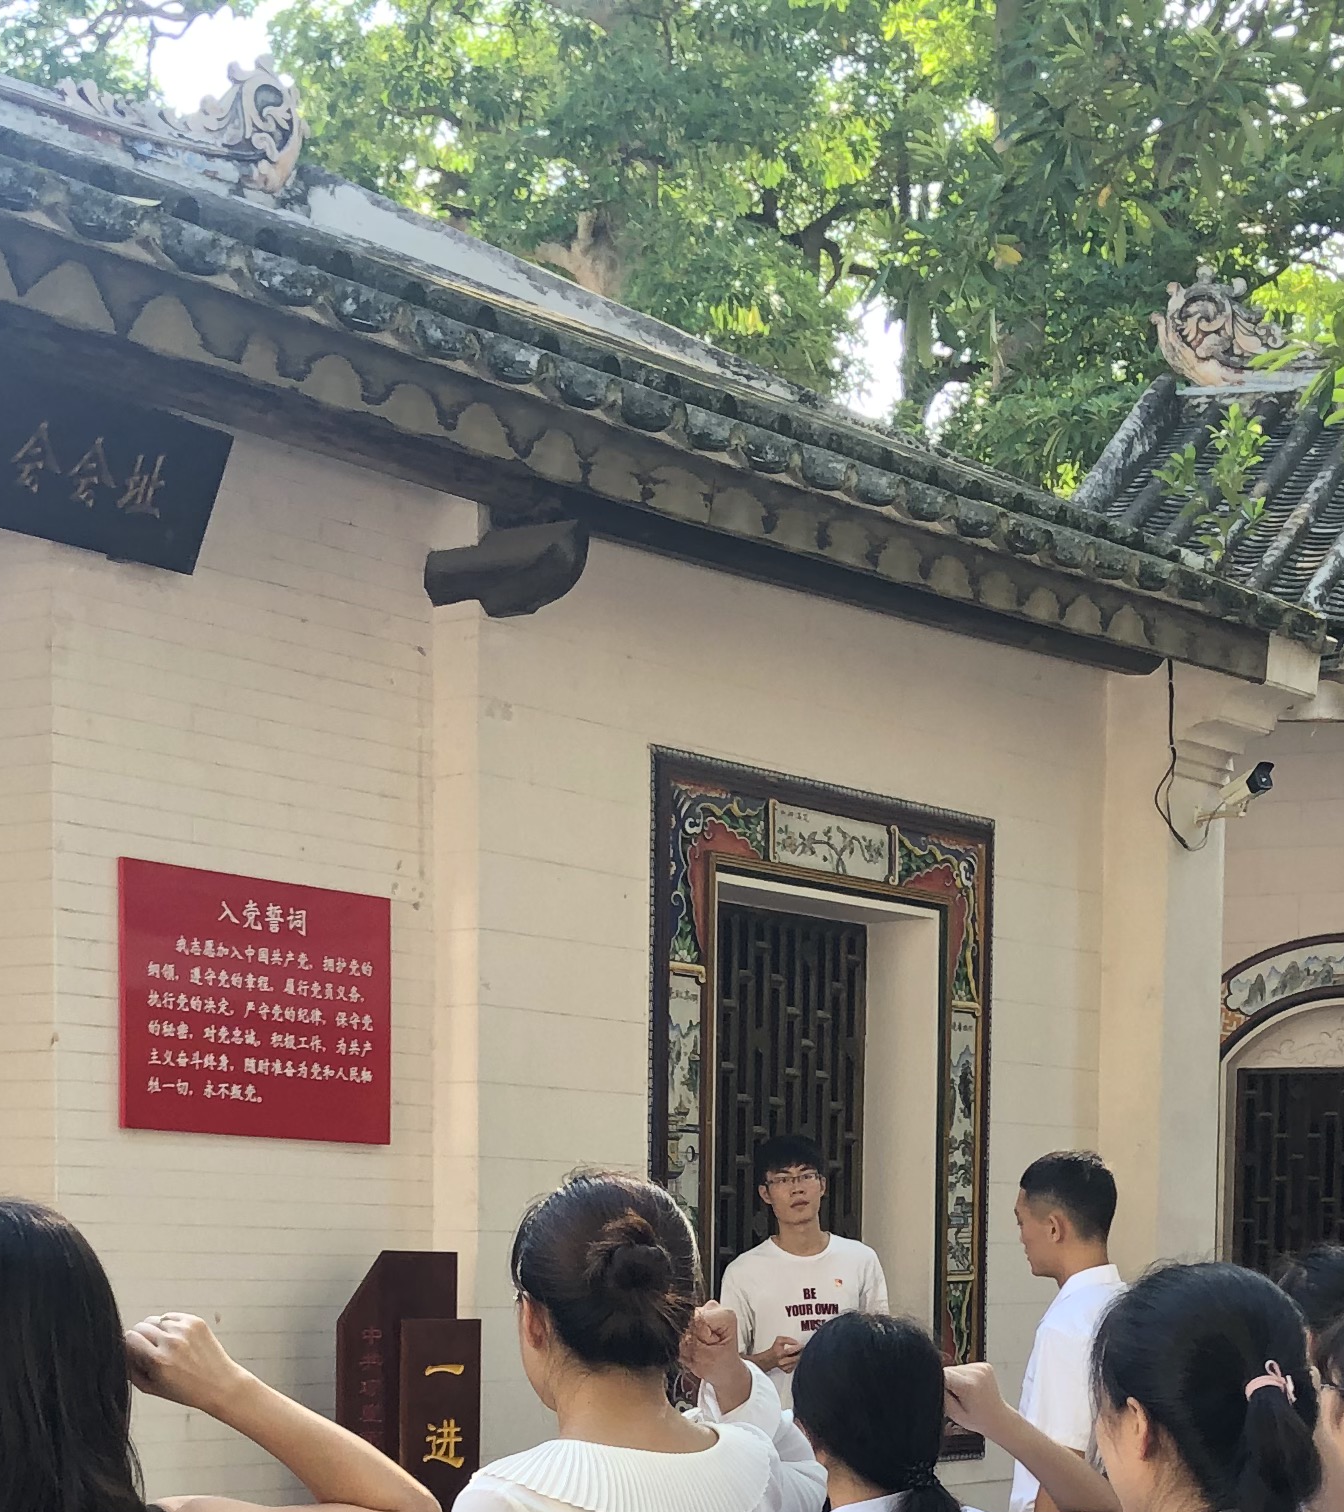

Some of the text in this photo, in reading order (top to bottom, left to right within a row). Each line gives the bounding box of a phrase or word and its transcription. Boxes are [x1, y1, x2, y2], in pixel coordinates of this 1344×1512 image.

[217, 899, 308, 936] 入党誓词
[802, 1287, 817, 1300] BE
[784, 1302, 839, 1318] YOUR OWN
